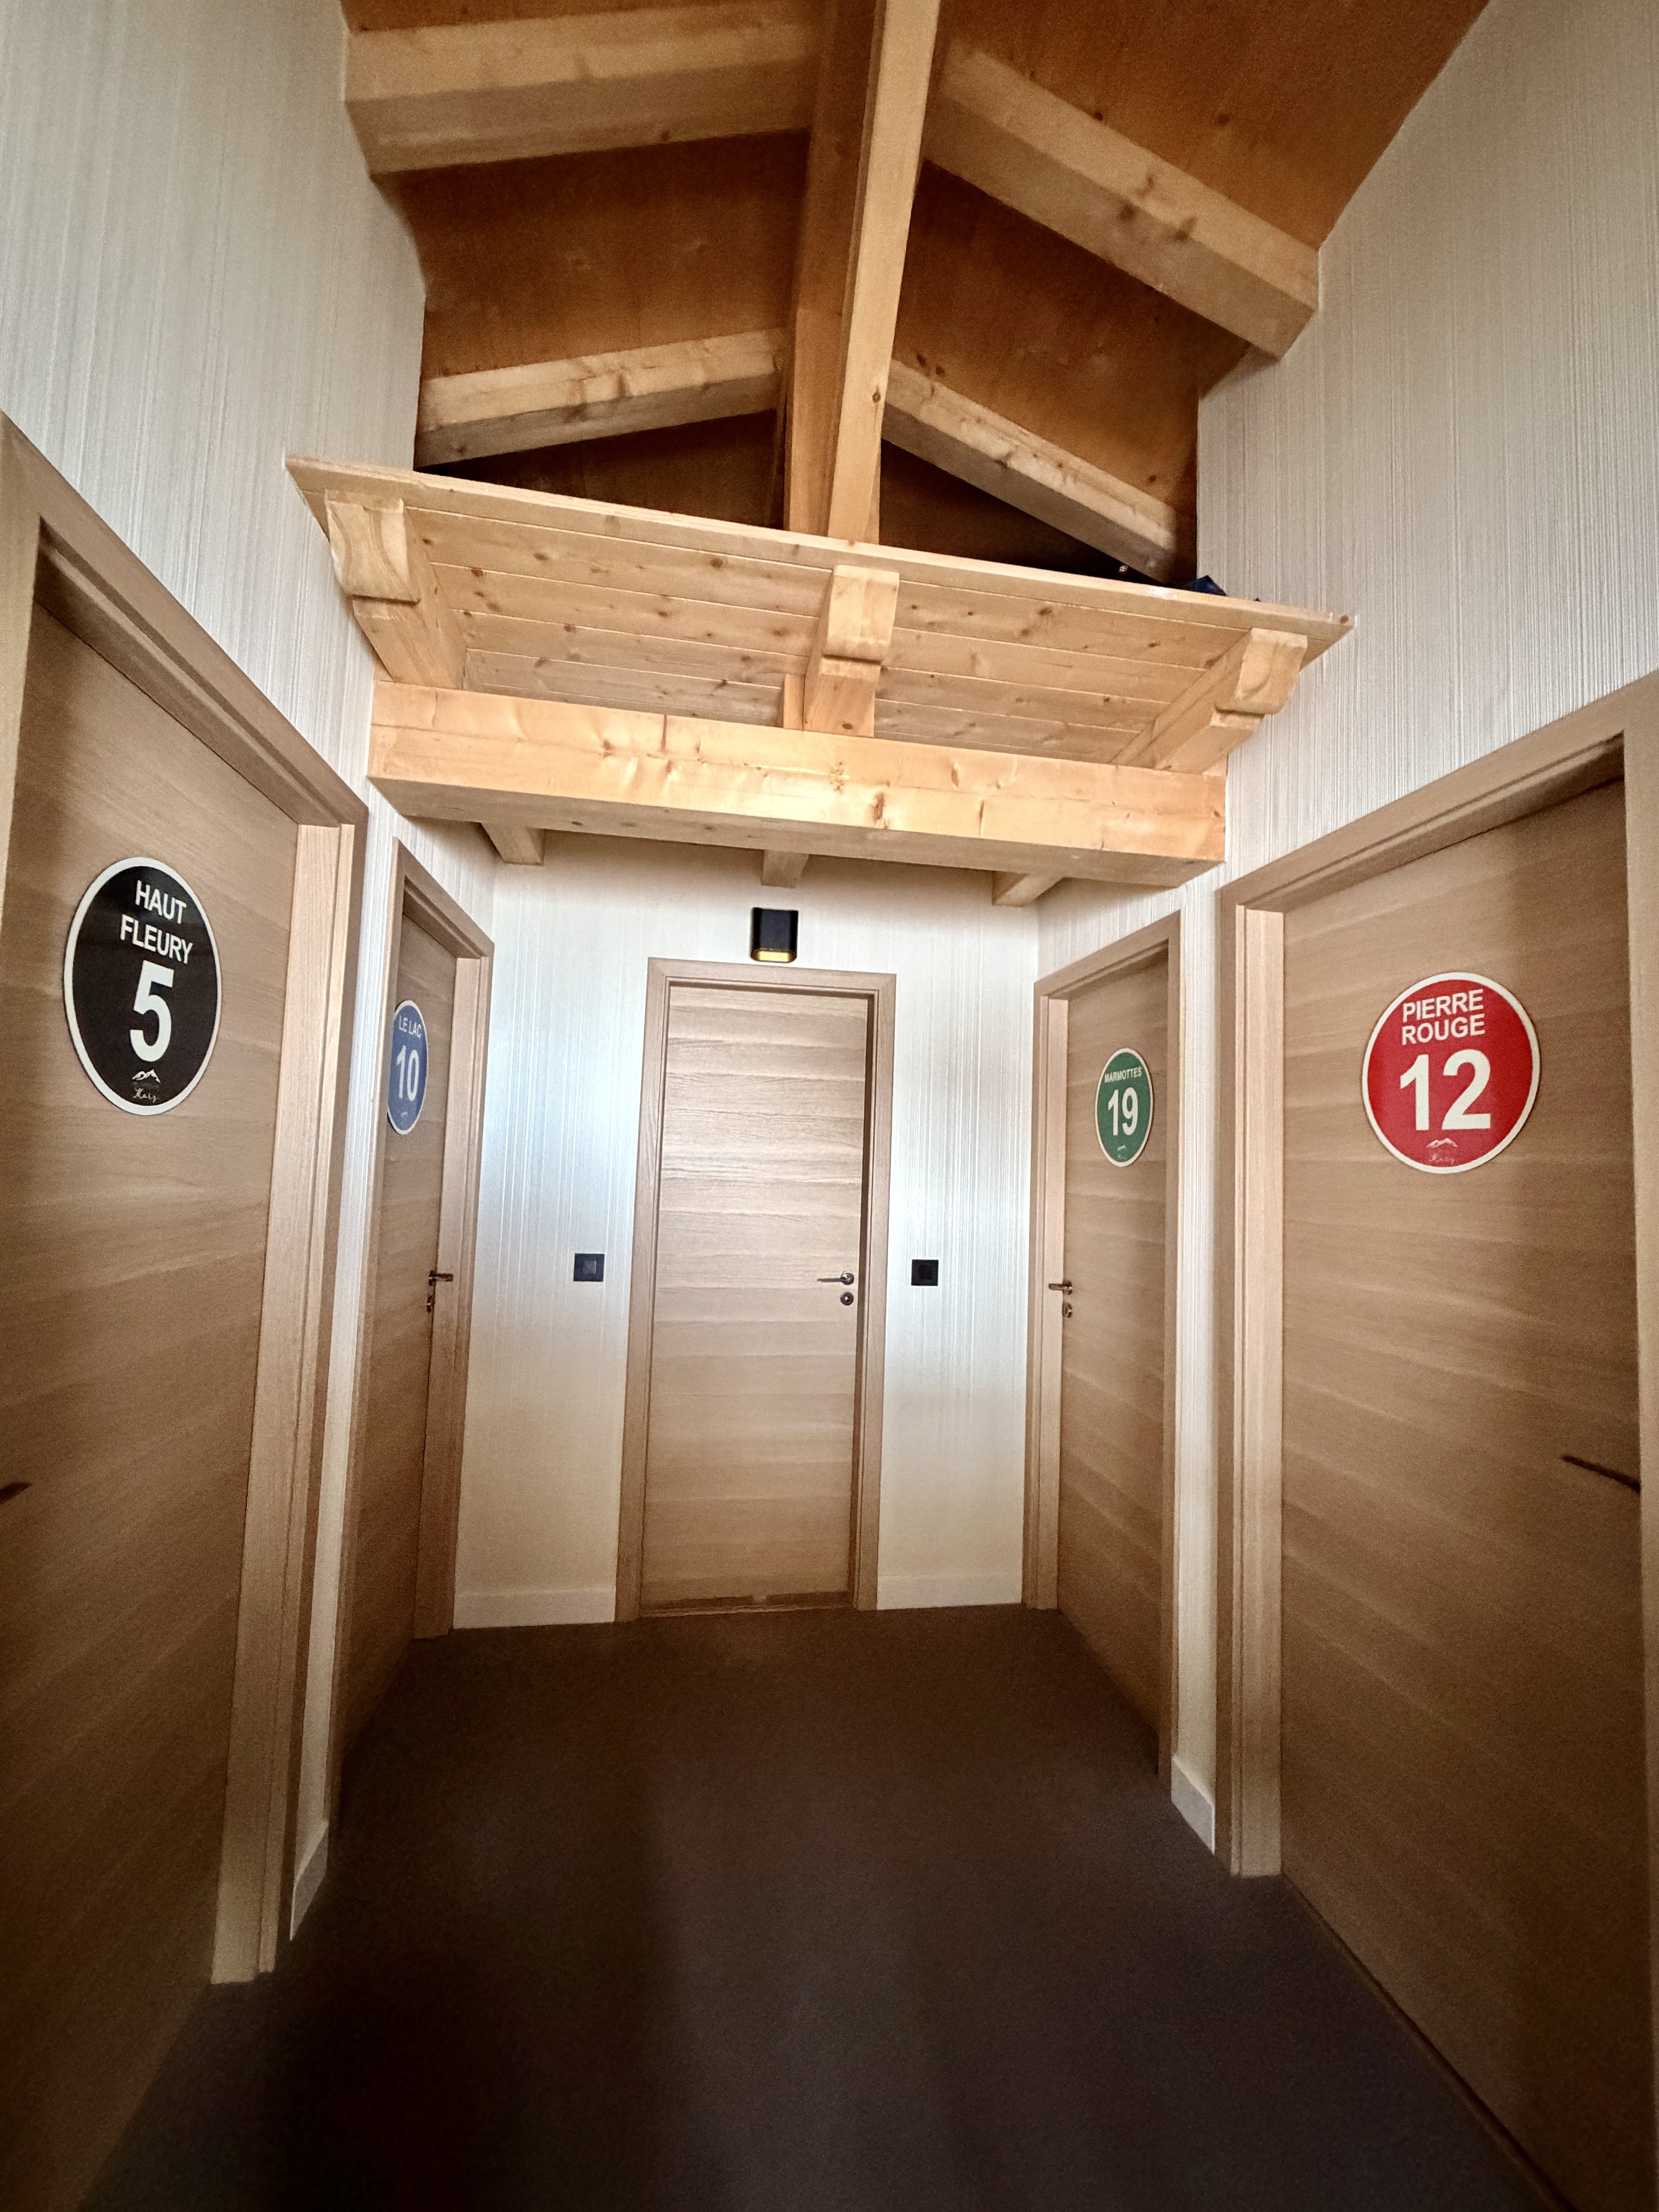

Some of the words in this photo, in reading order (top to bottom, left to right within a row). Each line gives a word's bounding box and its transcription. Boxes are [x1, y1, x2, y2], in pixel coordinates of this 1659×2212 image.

[135, 880, 187, 924] HAUT
[120, 914, 193, 964] FLEURY
[130, 960, 174, 1062] 5
[399, 1015, 408, 1033] LE
[409, 1020, 422, 1038] LAC
[1403, 988, 1484, 1022] PIERRE
[1402, 1013, 1486, 1046] ROUGE
[397, 1045, 419, 1101] 10
[1104, 1066, 1142, 1083] MARMOTTES
[1400, 1049, 1491, 1131] 12
[1108, 1087, 1138, 1136] 19
